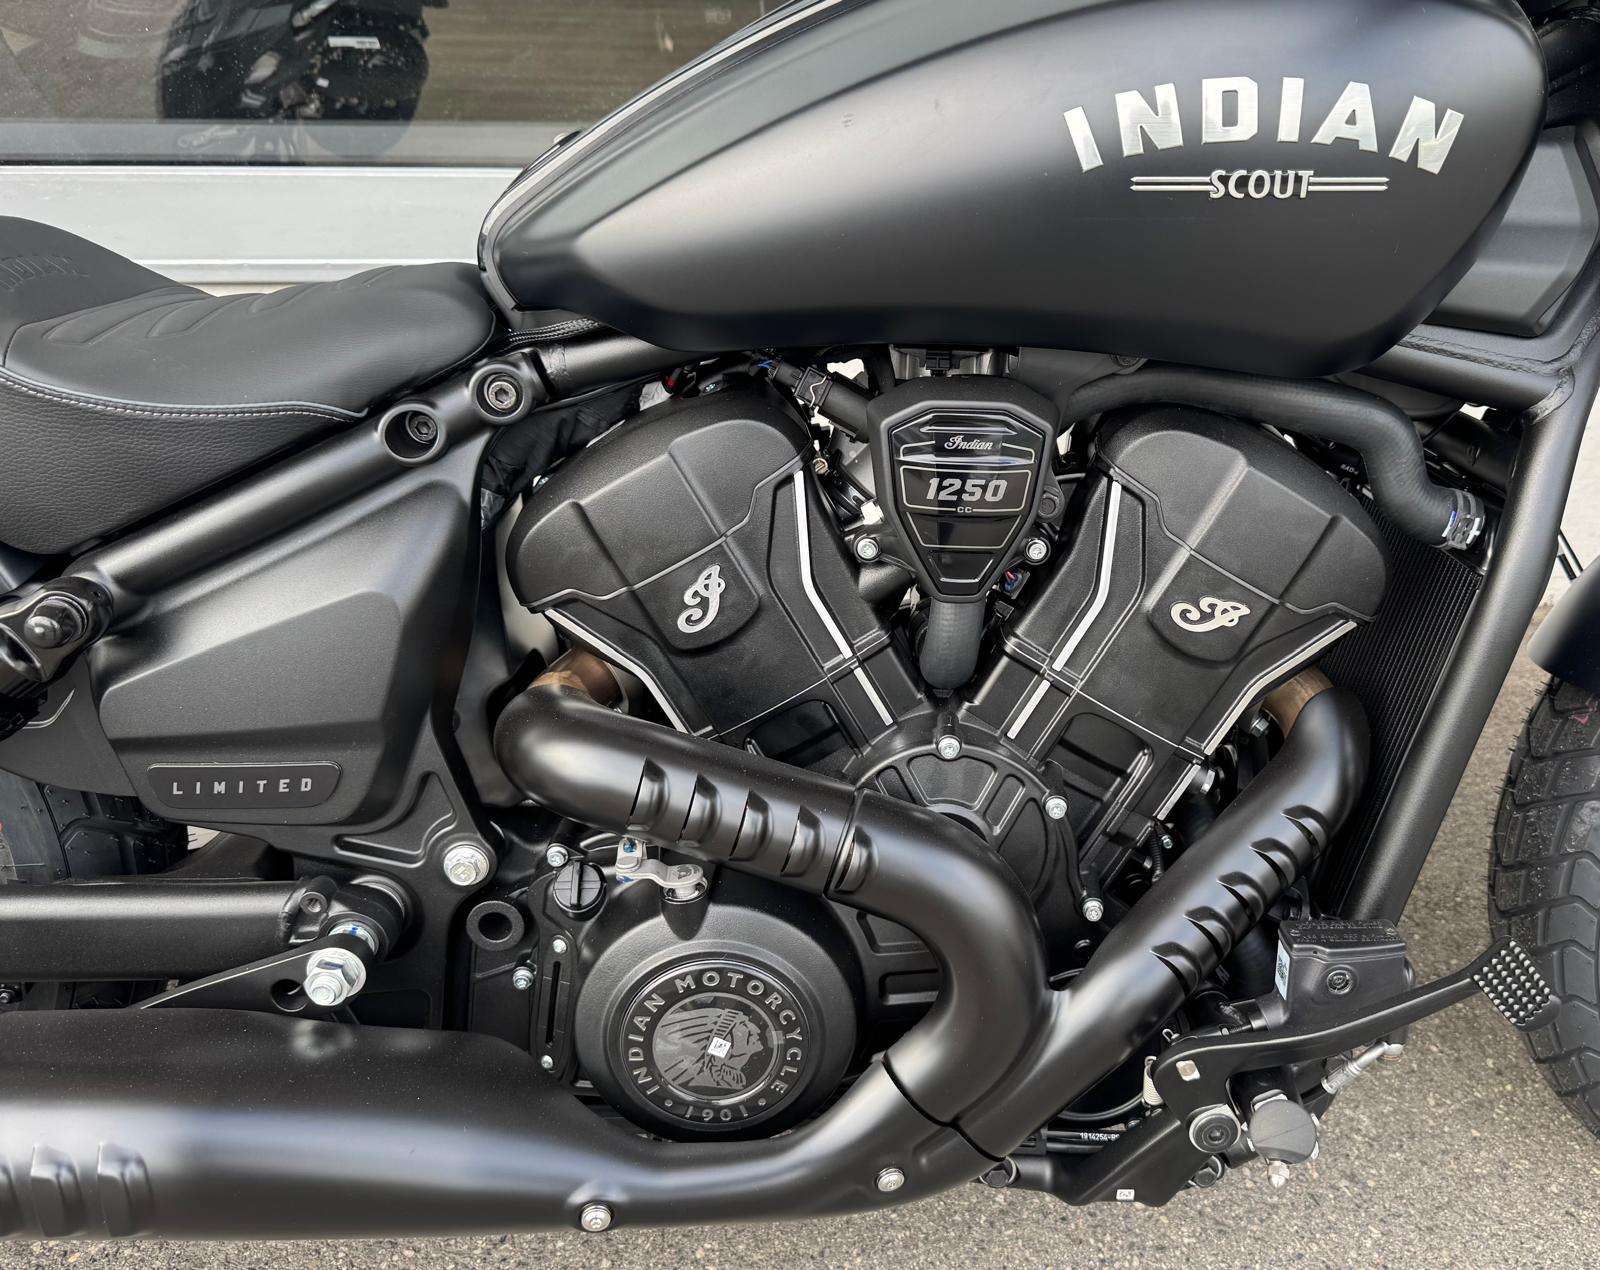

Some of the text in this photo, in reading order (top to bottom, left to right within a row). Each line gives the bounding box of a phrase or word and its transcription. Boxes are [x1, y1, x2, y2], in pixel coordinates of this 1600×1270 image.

[1064, 76, 1464, 175] INDIAN
[1209, 169, 1315, 199] SCOUT
[943, 434, 994, 451] Indian
[926, 477, 1008, 502] 1250
[957, 506, 973, 514] CC
[172, 777, 313, 795] LIMITED
[628, 970, 803, 1095] INDIAN MOTORCYCLE
